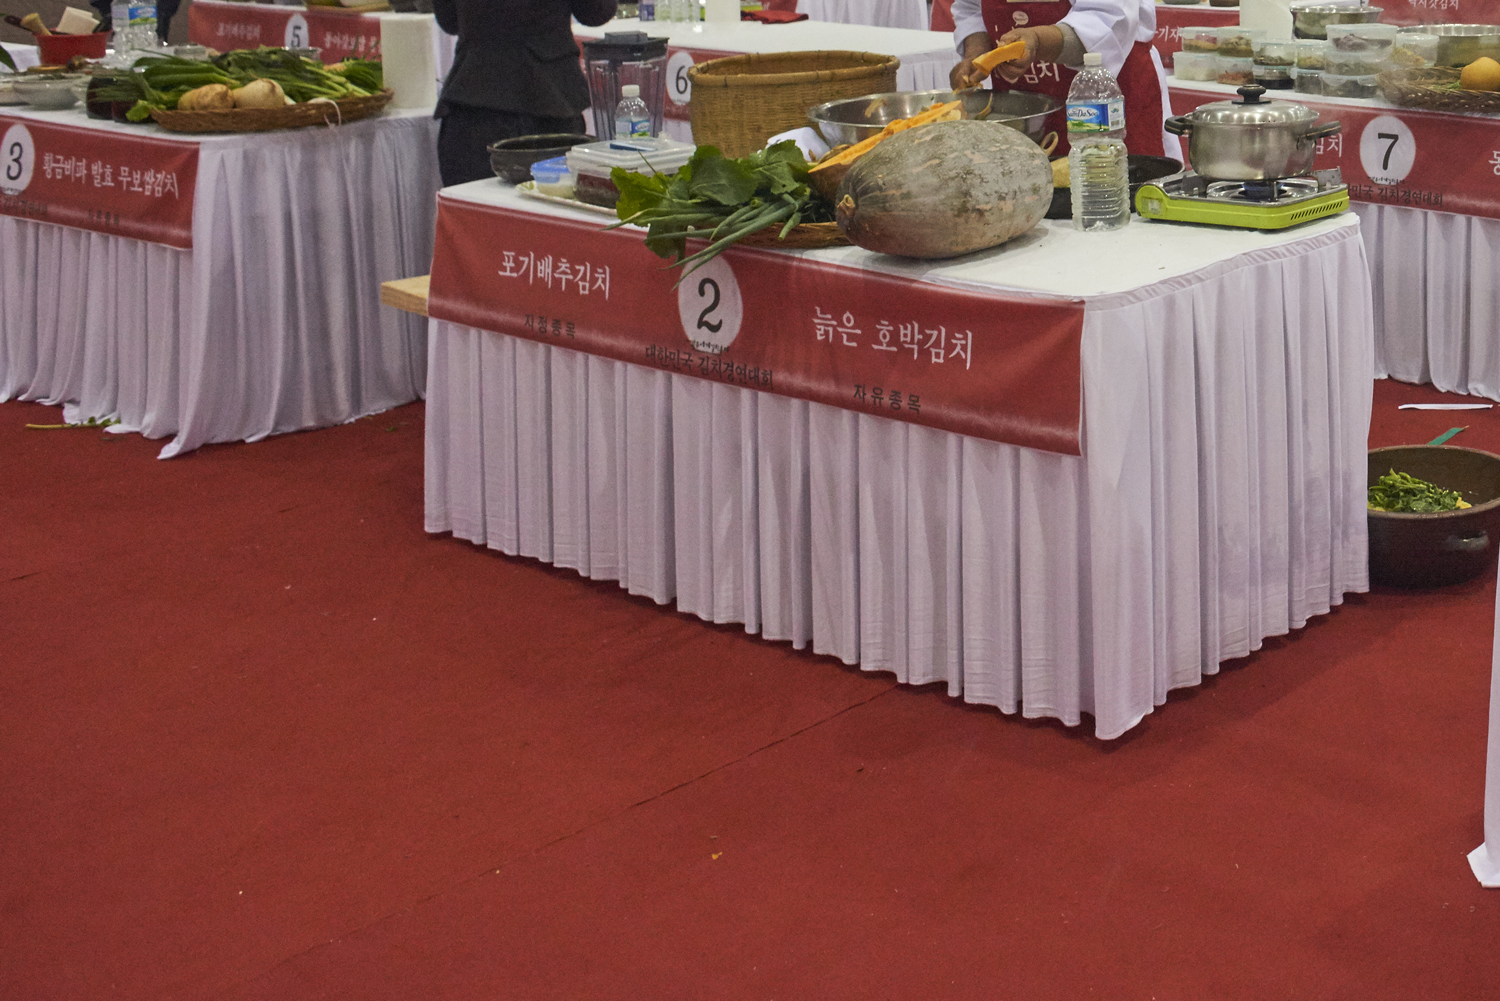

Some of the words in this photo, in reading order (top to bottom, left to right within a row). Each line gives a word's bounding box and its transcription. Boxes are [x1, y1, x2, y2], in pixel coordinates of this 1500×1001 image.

[290, 25, 302, 47] 5
[675, 65, 688, 95] 6
[6, 142, 23, 181] 3
[1377, 132, 1399, 171] 7
[42, 152, 87, 184] 황금비파
[91, 161, 115, 188] 발효
[117, 166, 179, 199] 무보쌈김치
[1377, 185, 1443, 207] 김치경연대회
[498, 251, 611, 301] 포기배추김치
[697, 277, 723, 333] 2
[524, 313, 576, 340] 지정종목
[812, 306, 862, 347] 늙은
[871, 319, 973, 370] 호박김치
[645, 344, 694, 371] 대한민국
[697, 356, 774, 390] 김치경연대회
[853, 383, 921, 415] 자유종목
